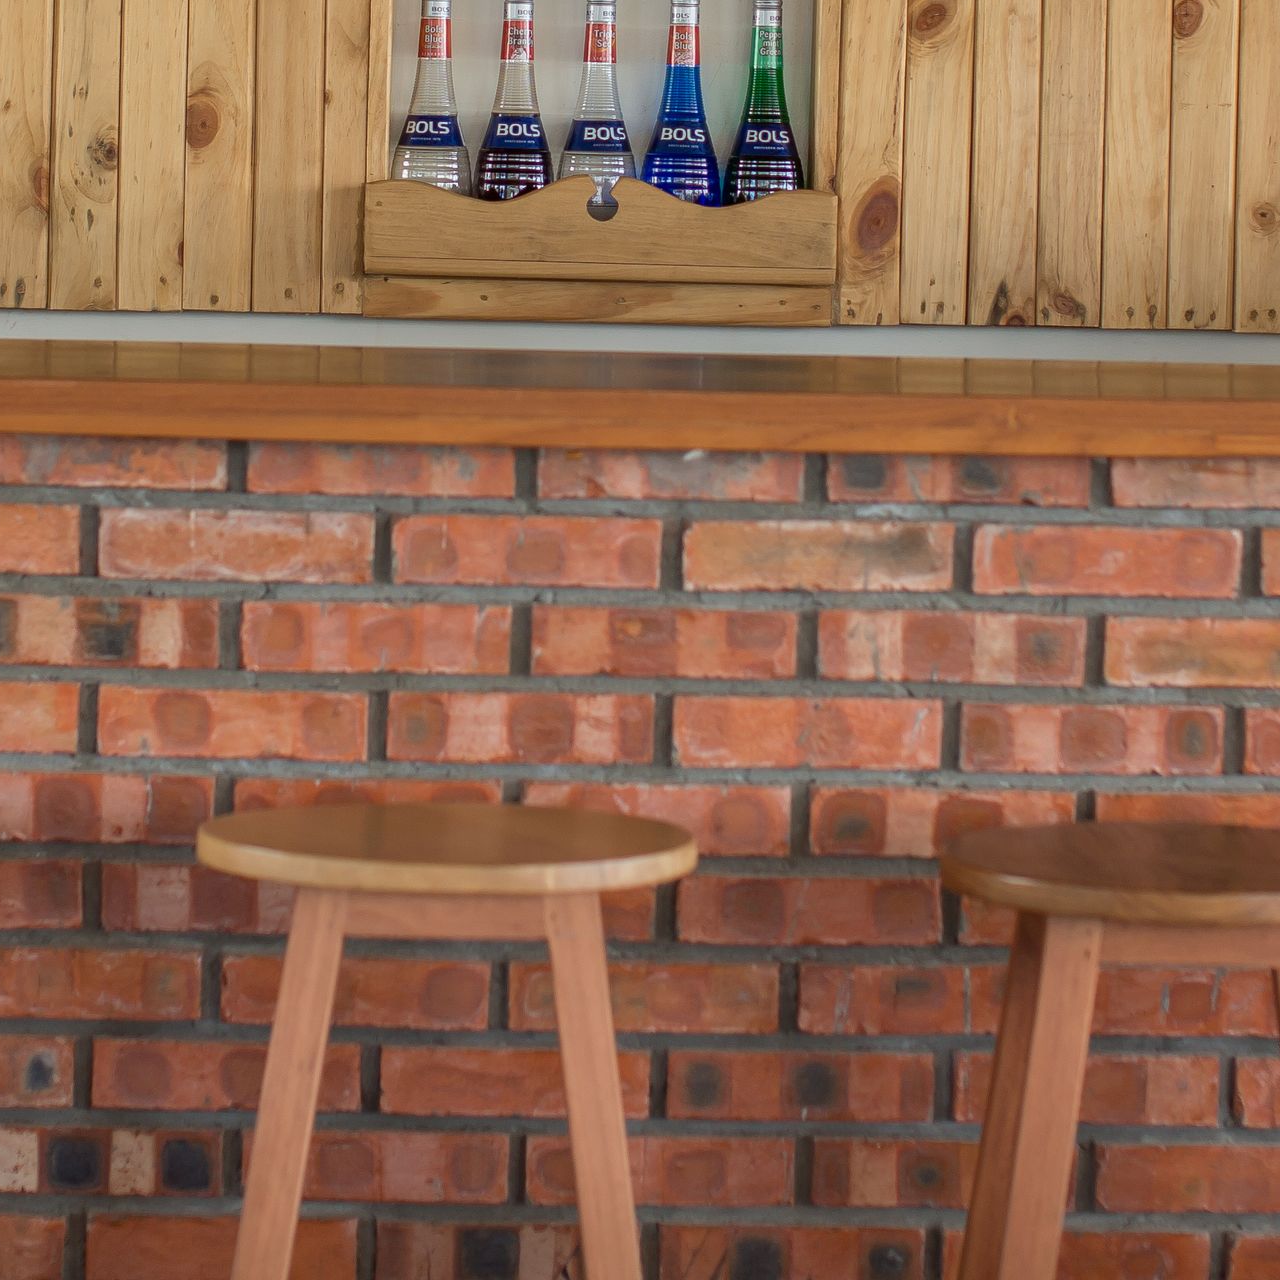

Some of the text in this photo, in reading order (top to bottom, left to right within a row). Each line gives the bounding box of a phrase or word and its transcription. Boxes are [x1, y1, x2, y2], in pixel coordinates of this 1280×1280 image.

[406, 120, 450, 135] BOLS
[496, 123, 541, 138] BOLS
[583, 126, 626, 141] BOLS
[661, 127, 706, 143] BOLS
[746, 129, 790, 144] BOLS
